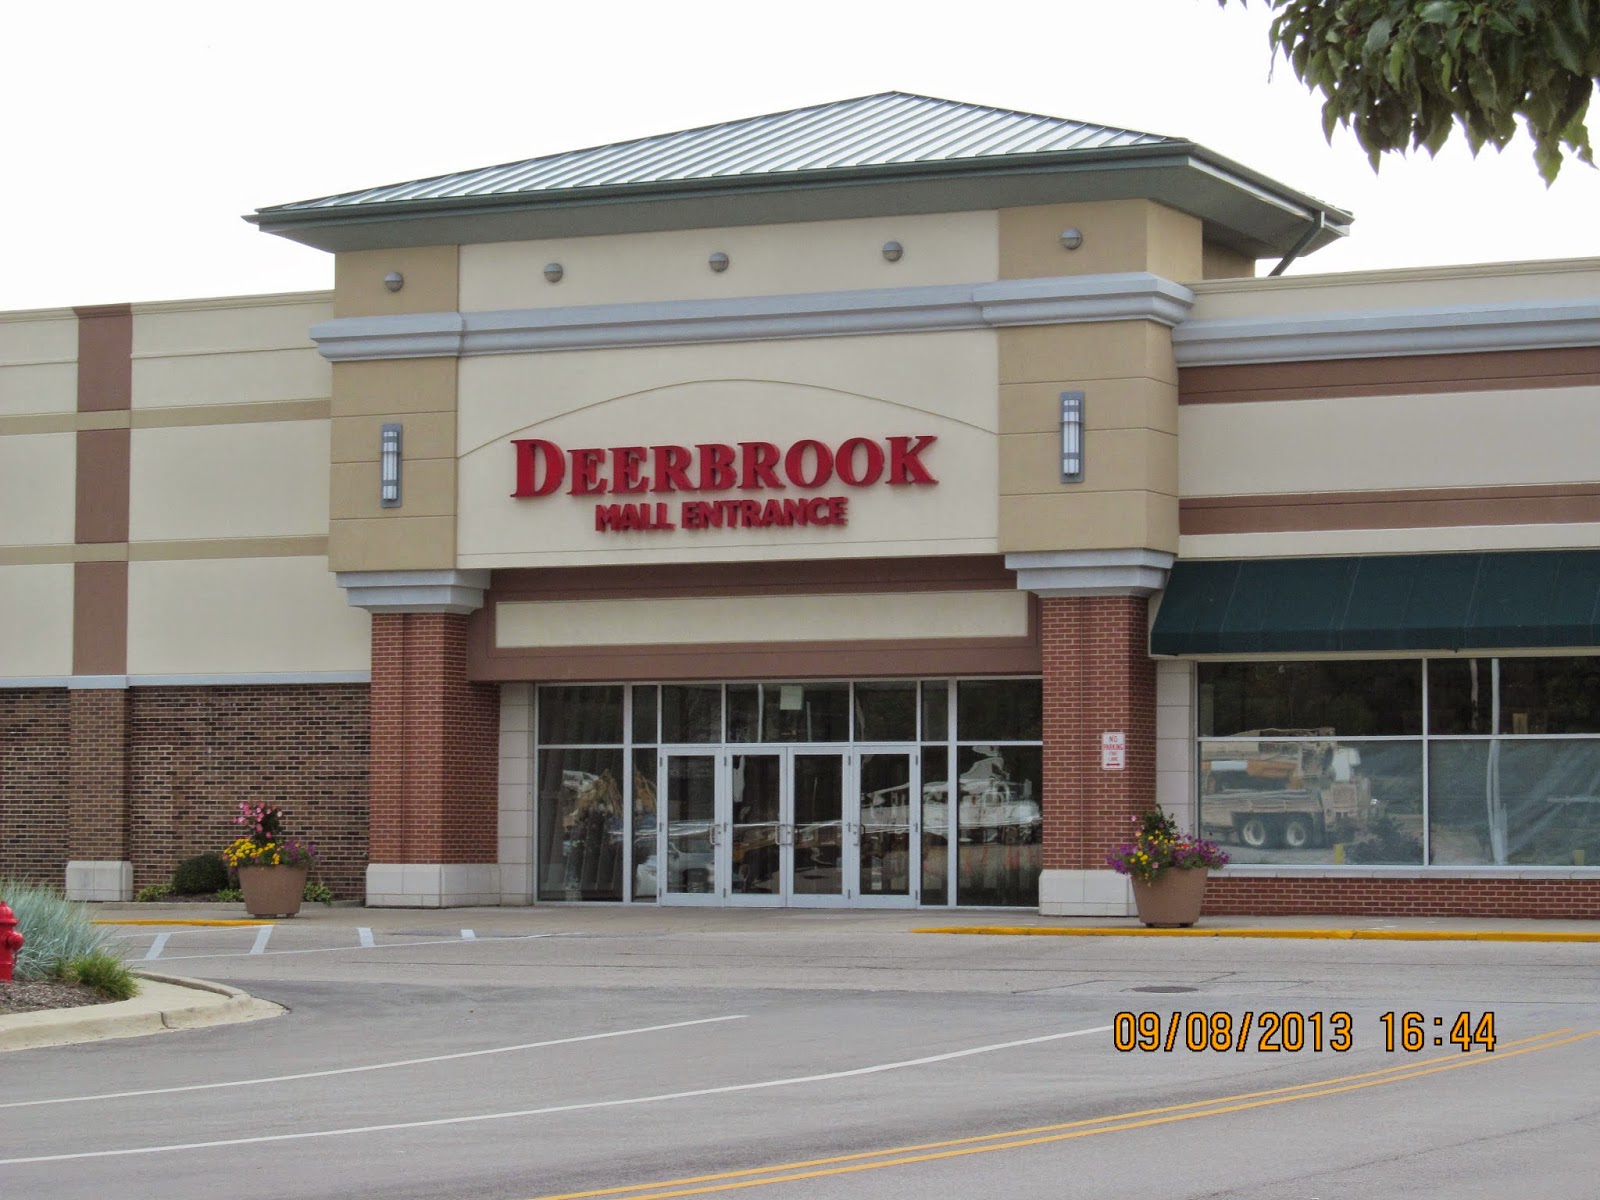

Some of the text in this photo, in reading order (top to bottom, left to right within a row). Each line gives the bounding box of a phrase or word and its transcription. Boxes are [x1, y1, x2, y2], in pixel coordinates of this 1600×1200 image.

[510, 435, 938, 498] DEERBROOK
[595, 496, 848, 532] MALL ENTRANCE
[1108, 735, 1118, 743] NO
